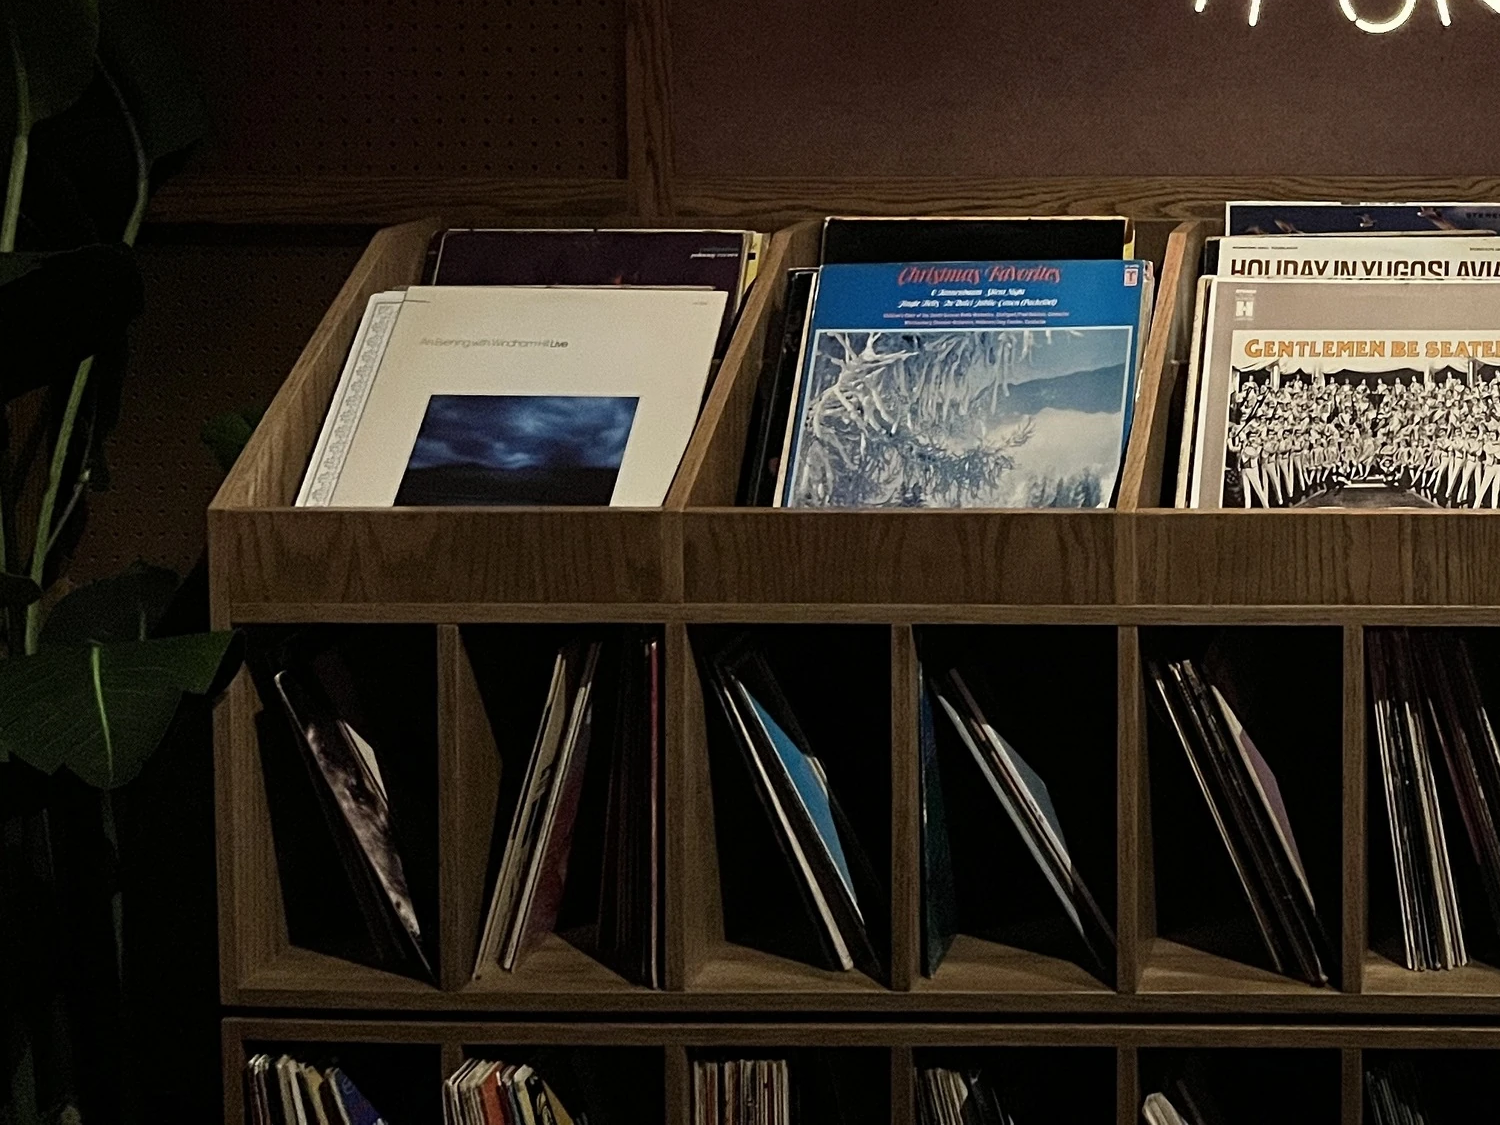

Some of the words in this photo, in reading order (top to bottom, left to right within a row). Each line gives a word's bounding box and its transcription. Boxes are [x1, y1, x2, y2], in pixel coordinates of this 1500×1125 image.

[898, 265, 982, 285] Christmas
[984, 264, 1062, 284] Favorites
[1334, 260, 1357, 276] IN
[1244, 338, 1386, 358] GENTLEMEN
[1390, 340, 1420, 357] BE
